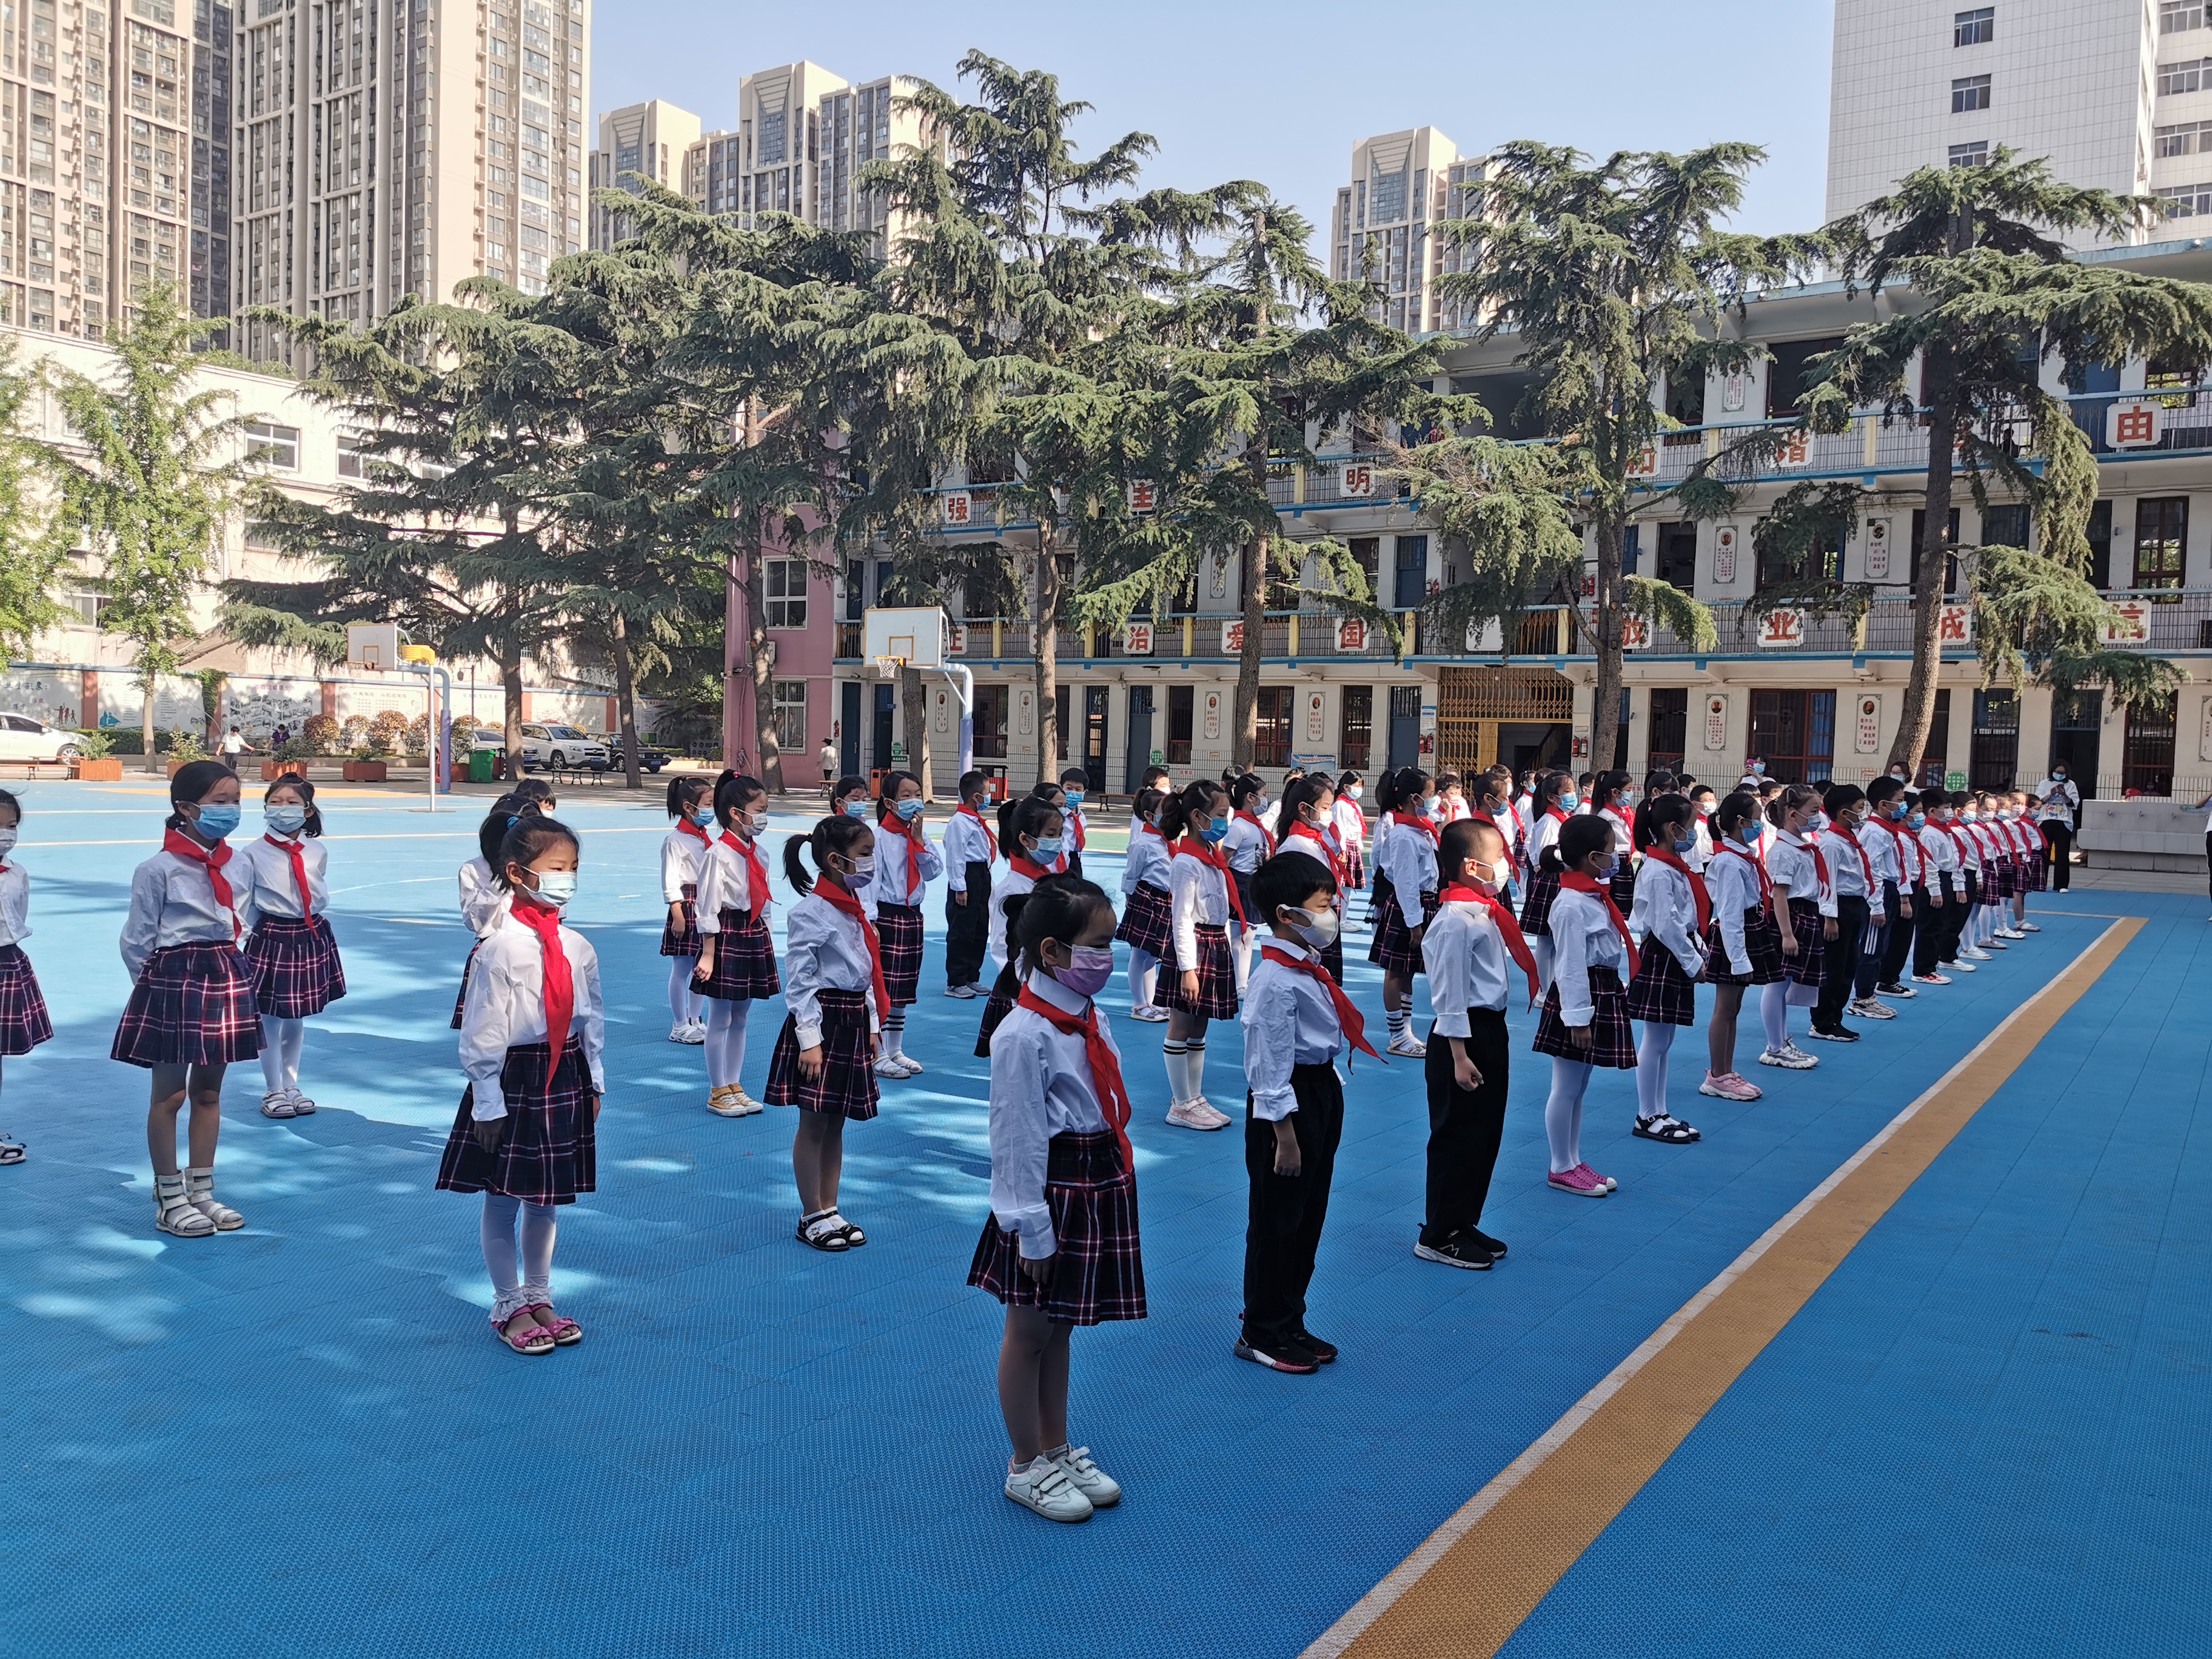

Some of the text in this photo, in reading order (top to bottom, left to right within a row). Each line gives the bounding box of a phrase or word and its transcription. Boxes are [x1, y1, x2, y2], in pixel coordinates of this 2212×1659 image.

[2117, 405, 2153, 443] 由
[1131, 481, 1153, 509] 主
[1346, 468, 1370, 495] 明
[947, 496, 968, 521] 强
[1340, 620, 1364, 650] 国
[1765, 611, 1798, 641] 业
[2108, 602, 2145, 640] 信
[1127, 626, 1150, 651] 治
